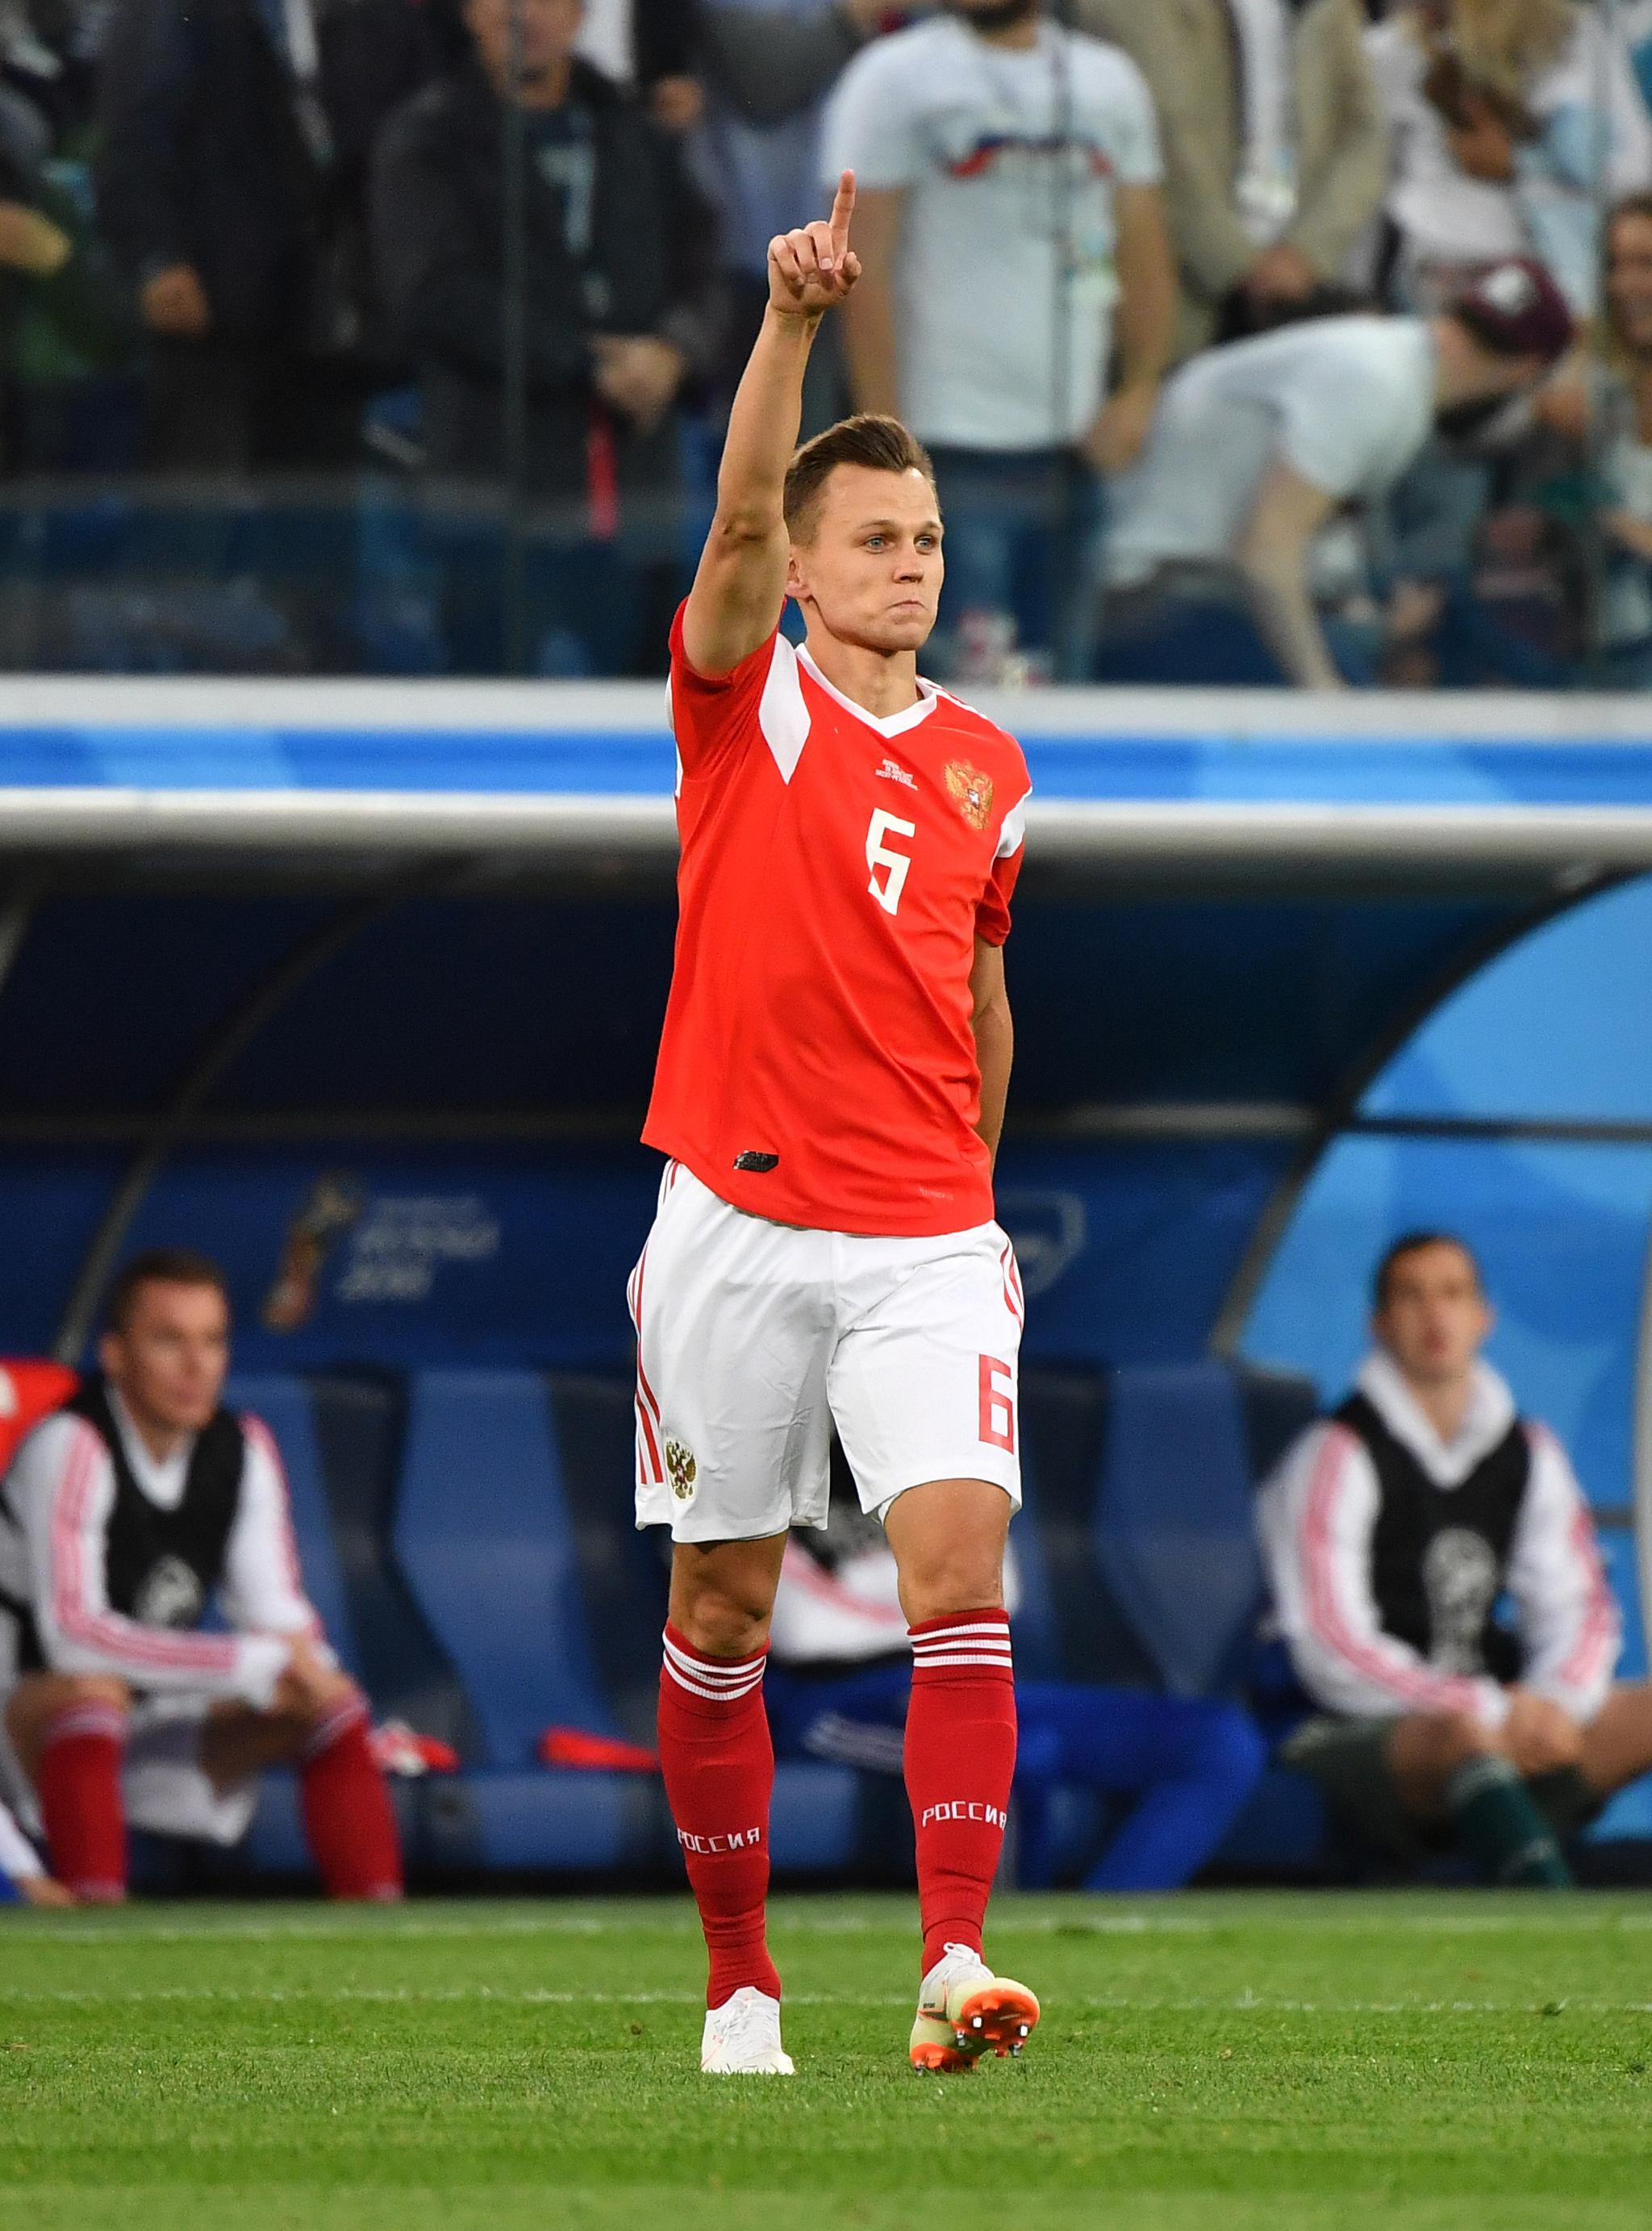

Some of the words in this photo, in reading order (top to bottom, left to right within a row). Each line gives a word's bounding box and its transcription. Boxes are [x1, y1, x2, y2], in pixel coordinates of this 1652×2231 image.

[978, 1353, 1015, 1456] 6
[922, 1800, 1007, 1832] РОССИЯ
[677, 1826, 760, 1854] РОССИЯ
